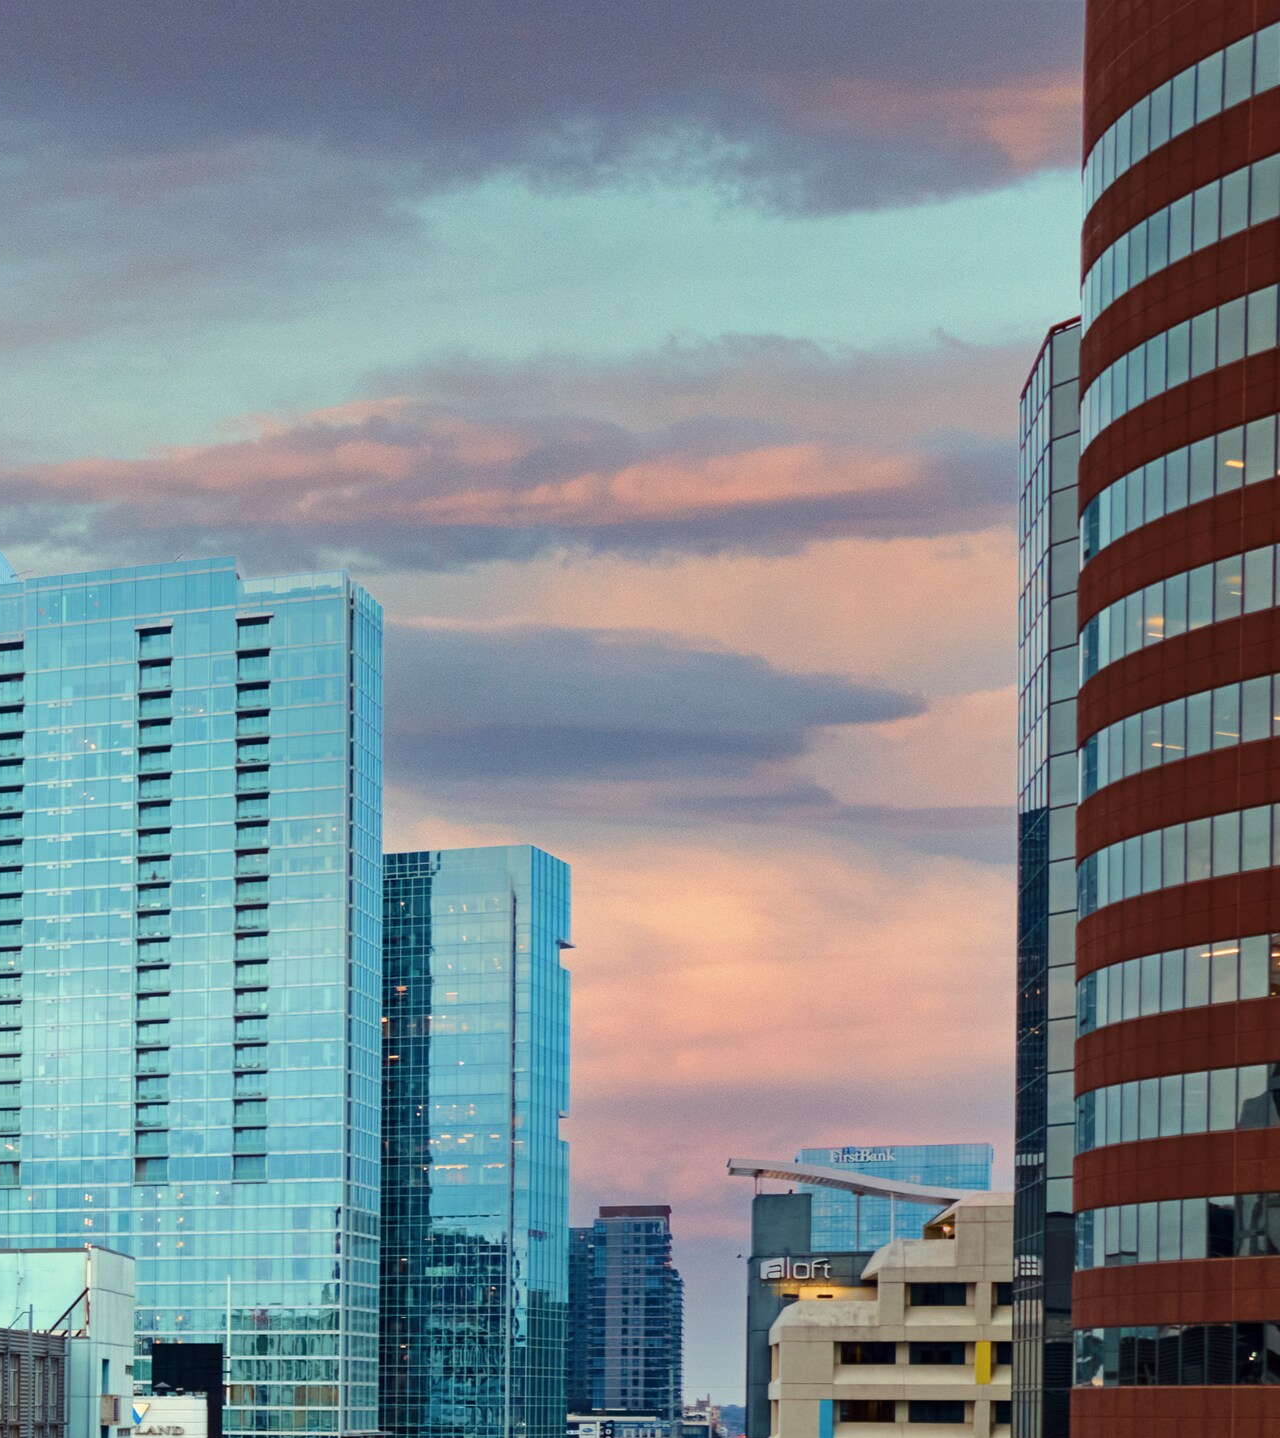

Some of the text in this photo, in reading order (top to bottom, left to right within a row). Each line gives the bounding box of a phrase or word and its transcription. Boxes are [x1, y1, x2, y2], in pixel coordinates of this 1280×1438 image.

[830, 1148, 897, 1163] FirstBank
[760, 1256, 832, 1280] aloft
[132, 1425, 185, 1436] LAND
